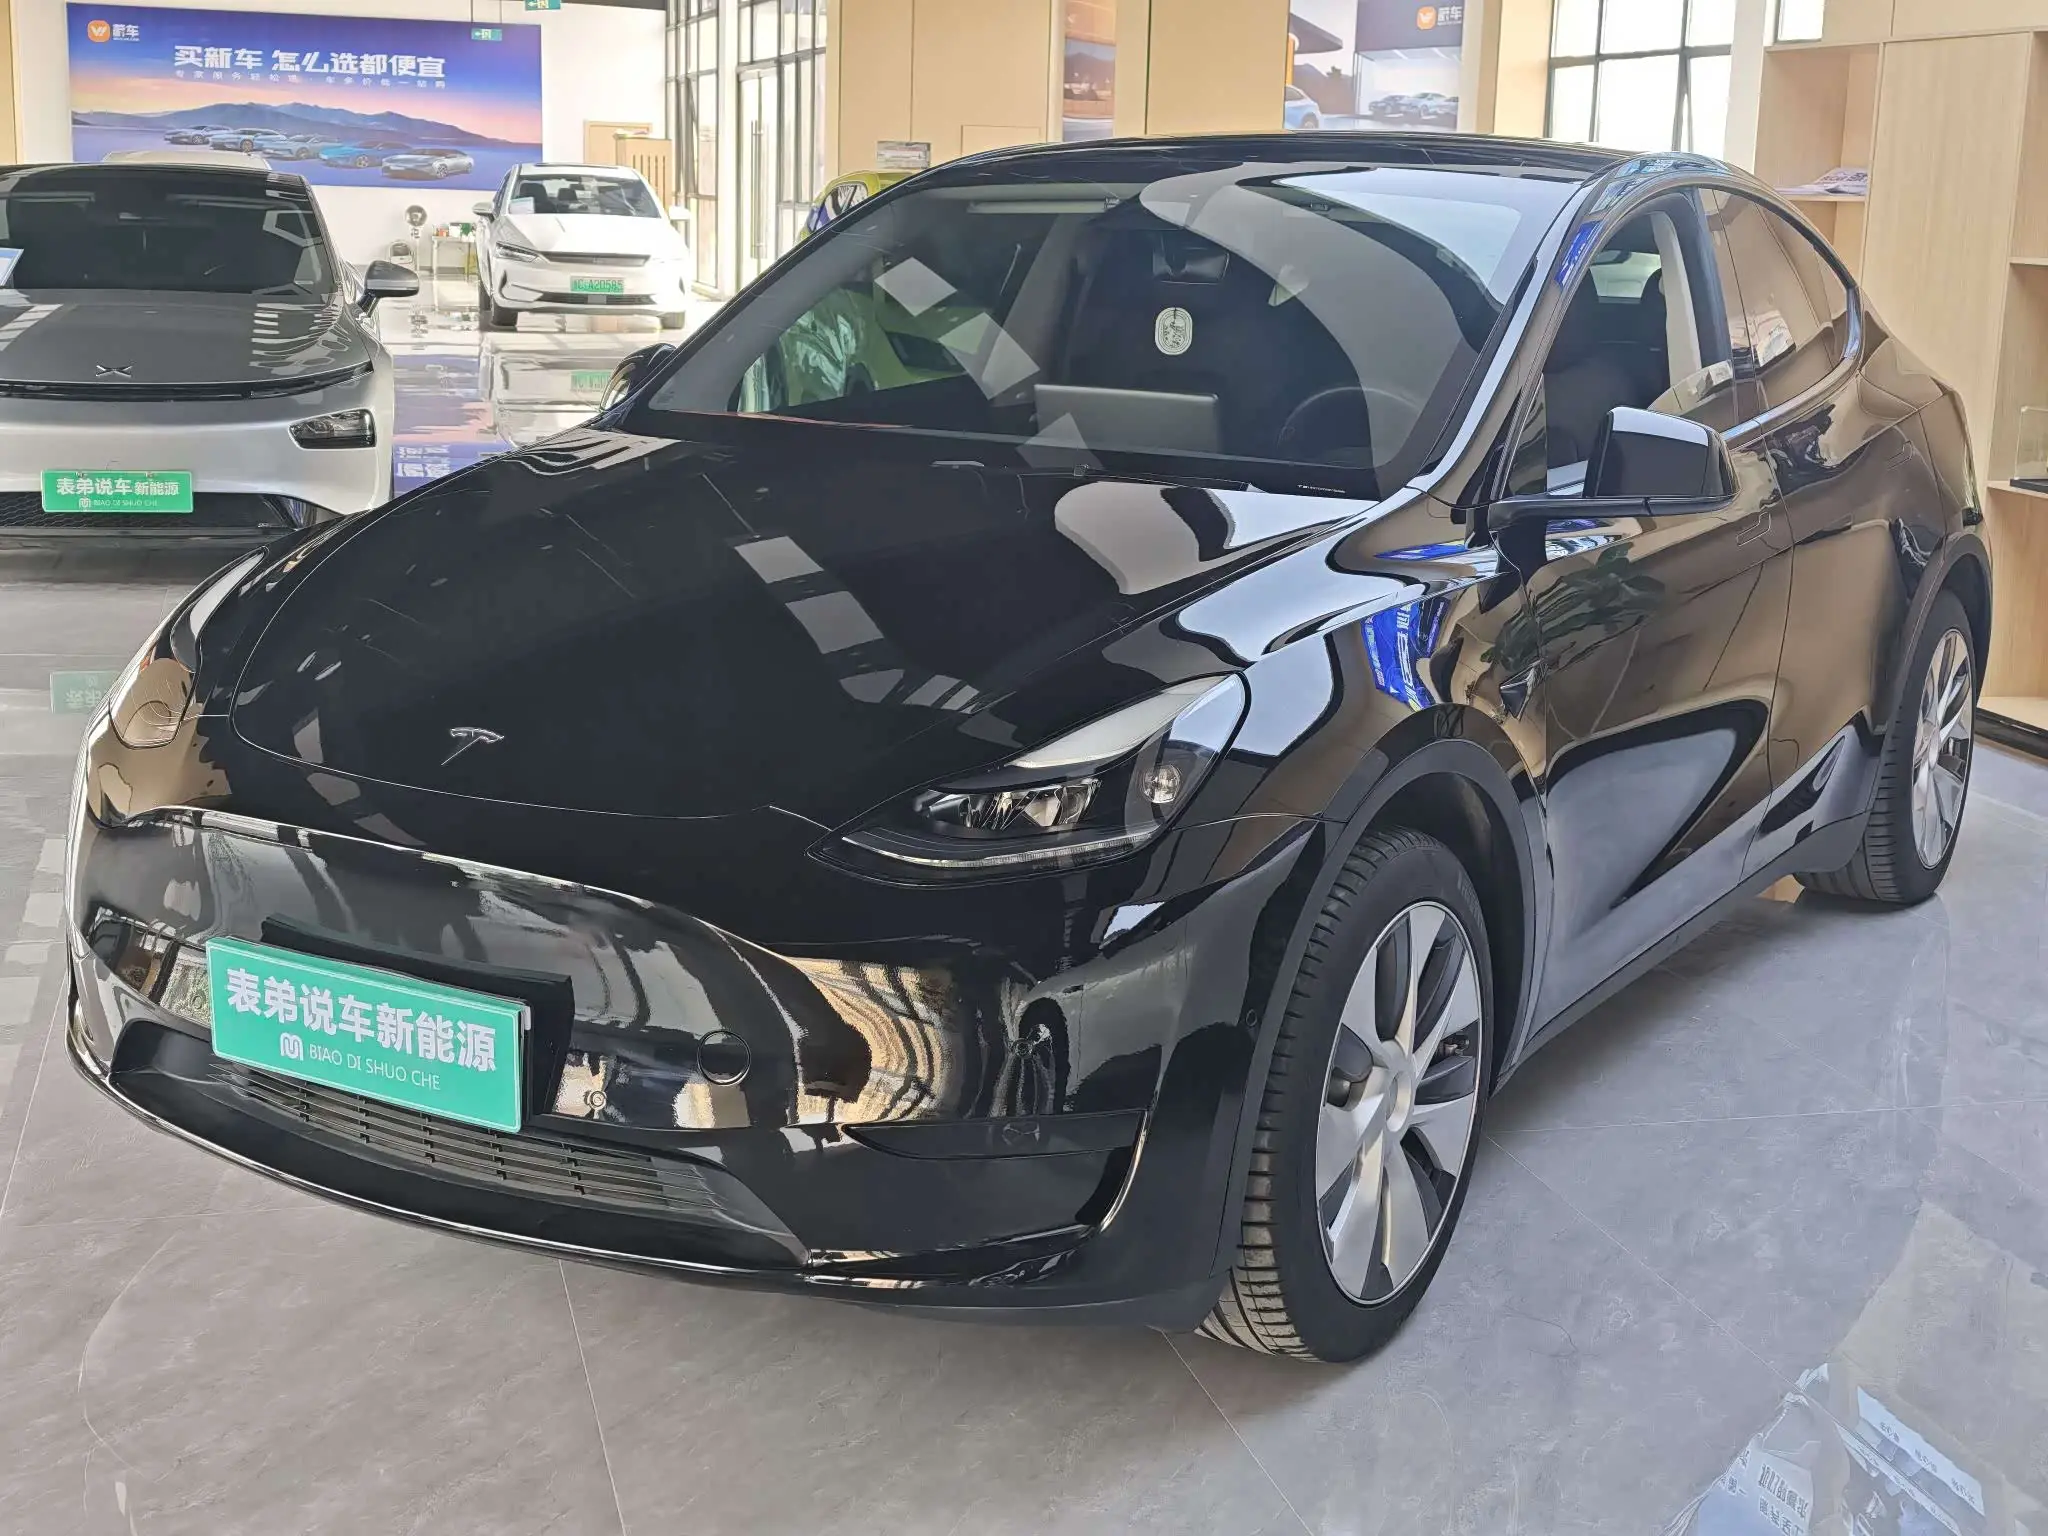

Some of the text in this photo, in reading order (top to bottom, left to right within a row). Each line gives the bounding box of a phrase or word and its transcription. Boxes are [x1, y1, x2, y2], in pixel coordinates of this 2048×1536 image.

[174, 45, 446, 78] 买新车 怎么选都便宜
[226, 967, 497, 1073] 表弟说车新能源
[309, 1044, 441, 1091] BIAO DI SHUO CHE
